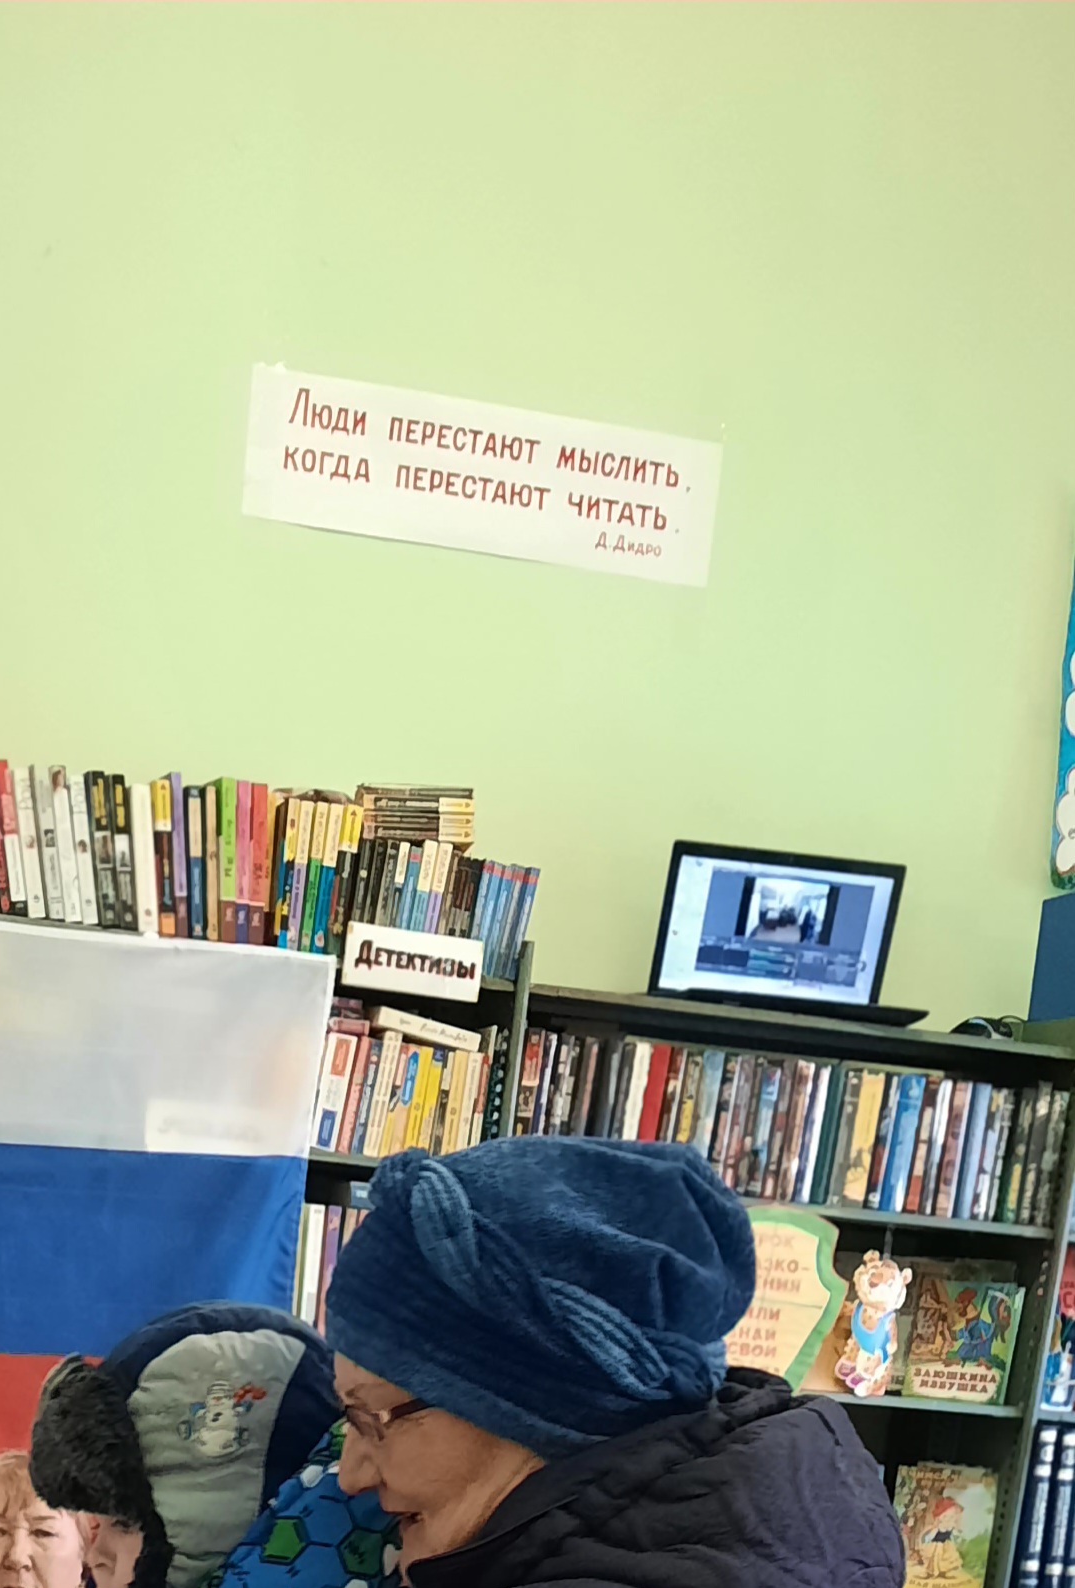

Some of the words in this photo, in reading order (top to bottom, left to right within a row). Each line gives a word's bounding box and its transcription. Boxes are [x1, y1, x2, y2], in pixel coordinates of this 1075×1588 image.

[288, 388, 368, 437] ЛЮДИ
[388, 416, 542, 465] ПЕРЕСТАЮТ
[556, 445, 691, 494] МЫСЛИТЬ,
[283, 445, 371, 484] КОГДА
[395, 464, 552, 512] ПЕРЕСТАЮТ
[568, 491, 680, 534] ЧИТАТЬ.
[758, 1235, 795, 1249] РОК
[914, 1367, 997, 1384] ЗАЮШКИНА
[919, 1378, 989, 1394] ИЗБУШКА
